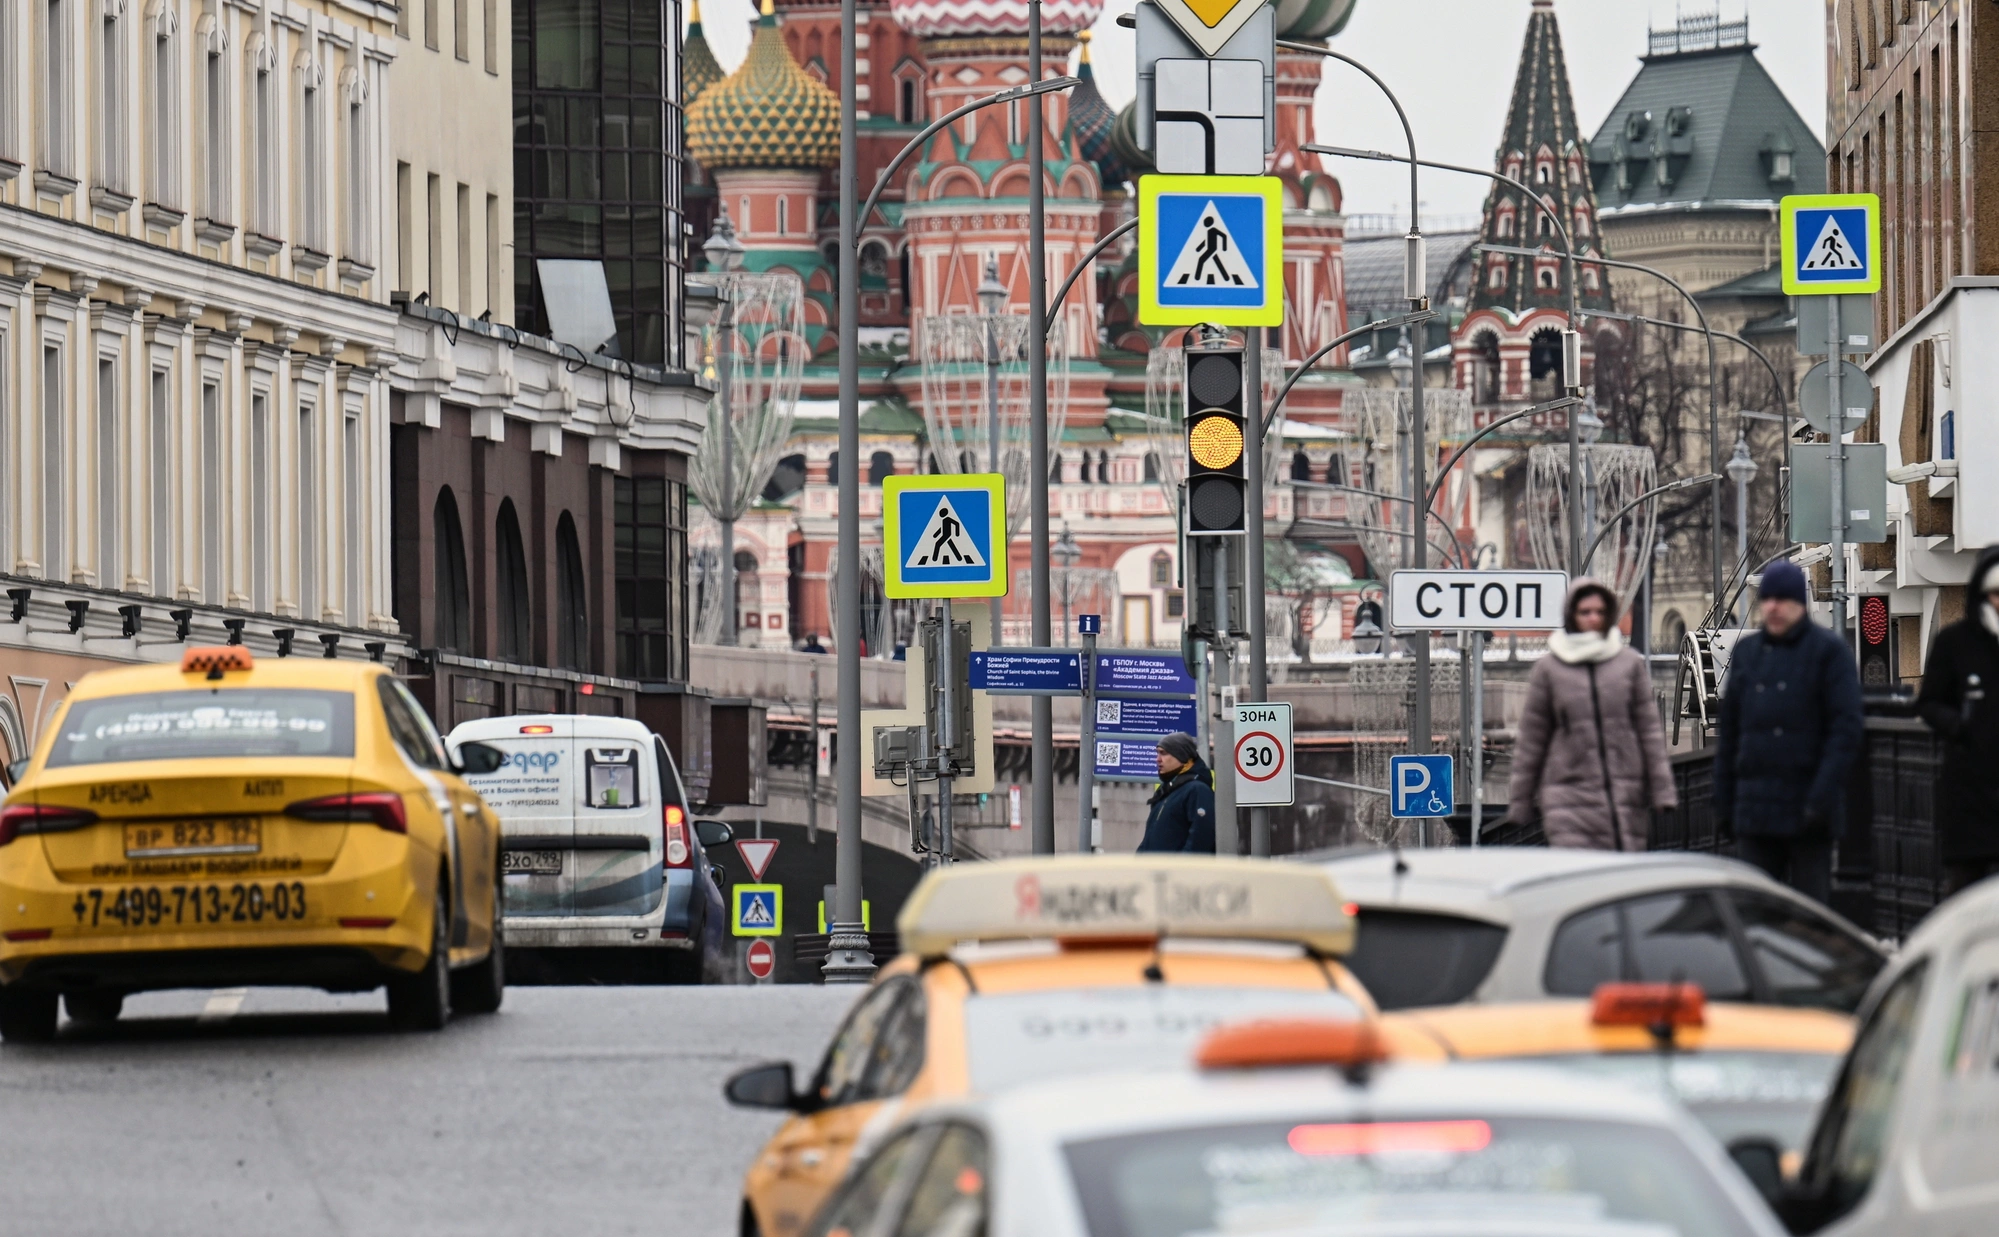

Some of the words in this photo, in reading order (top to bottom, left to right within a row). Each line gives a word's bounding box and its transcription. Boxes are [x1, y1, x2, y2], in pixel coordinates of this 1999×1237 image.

[1416, 581, 1542, 619] СТОП
[1240, 711, 1277, 722] ЗОНА
[1245, 746, 1273, 767] 30
[89, 782, 153, 804] АРЕНДА
[243, 780, 284, 797] АКПП
[468, 777, 521, 786] Безлимитная
[527, 786, 559, 794] офисе!
[1398, 762, 1431, 811] P
[92, 860, 204, 877] ПРИГЛАШАЕМ
[206, 856, 303, 873] ВОДИТЕЛЕЙ
[73, 881, 307, 928] +7-499-713-20-03
[1014, 873, 1144, 923] Яндекс
[1154, 870, 1252, 921] Такси
